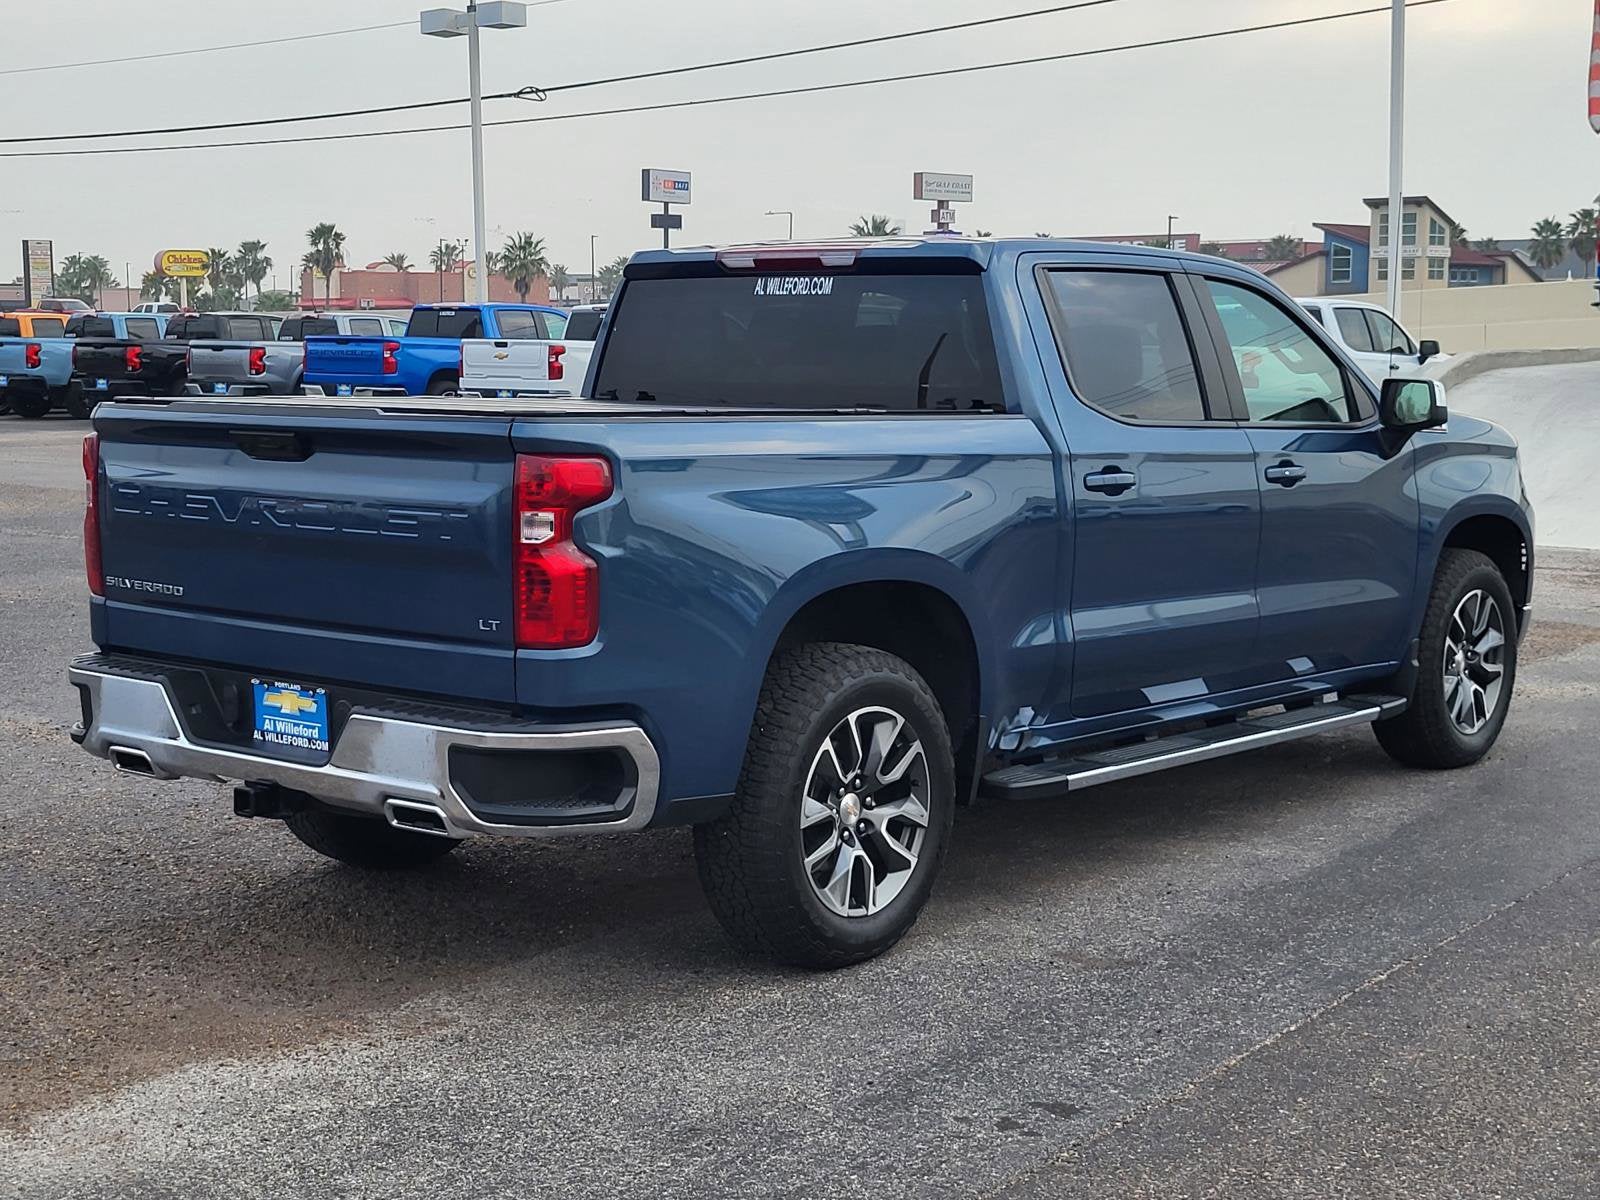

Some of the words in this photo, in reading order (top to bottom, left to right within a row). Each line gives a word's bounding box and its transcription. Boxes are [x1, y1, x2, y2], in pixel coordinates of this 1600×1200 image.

[167, 254, 205, 264] Chicken
[754, 277, 765, 295] AL
[766, 277, 834, 295] WILLEFORD.COM
[113, 488, 469, 540] CHEVROLET
[105, 576, 184, 596] SILVERADO
[479, 619, 501, 631] LT
[274, 681, 301, 691] PORTLAND
[263, 719, 274, 731] Al
[275, 720, 319, 738] Willeford
[253, 729, 264, 741] AL
[264, 731, 329, 752] WILLEFORD.COM
